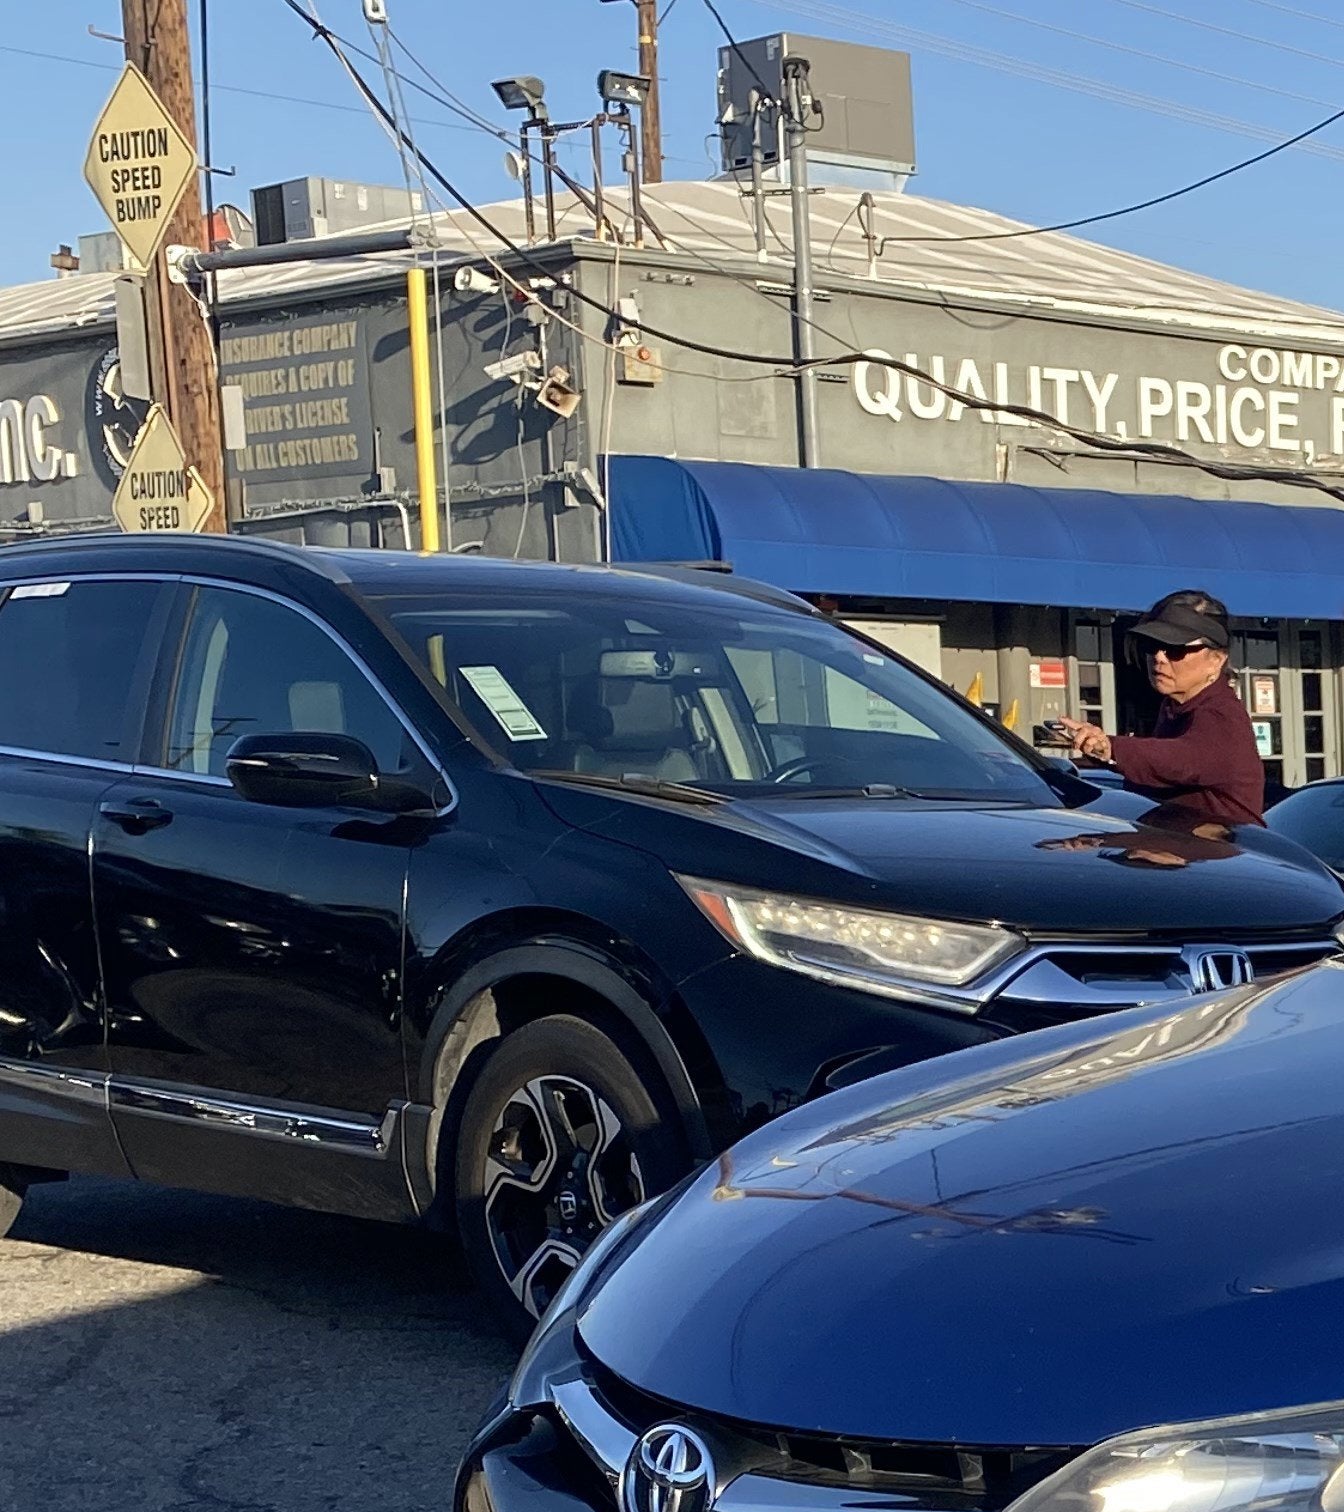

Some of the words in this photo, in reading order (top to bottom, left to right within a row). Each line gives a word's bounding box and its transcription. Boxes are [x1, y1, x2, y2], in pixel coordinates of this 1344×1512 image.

[99, 127, 168, 163] CAUTION
[111, 165, 161, 193] SPEED
[116, 195, 161, 222] BUMP
[293, 321, 357, 355] COMPANY
[288, 366, 298, 393] A
[300, 361, 335, 391] COPY
[337, 358, 355, 387] OF
[245, 403, 294, 434] RIVER'S
[295, 397, 350, 428] LICENSE
[852, 349, 1128, 439] QUALITY,
[1138, 376, 1315, 465] PRICE,
[256, 442, 278, 470] ALL
[278, 434, 359, 468] CUSTOMERS
[131, 470, 185, 500] CAUTION
[140, 505, 179, 530] SPEED
